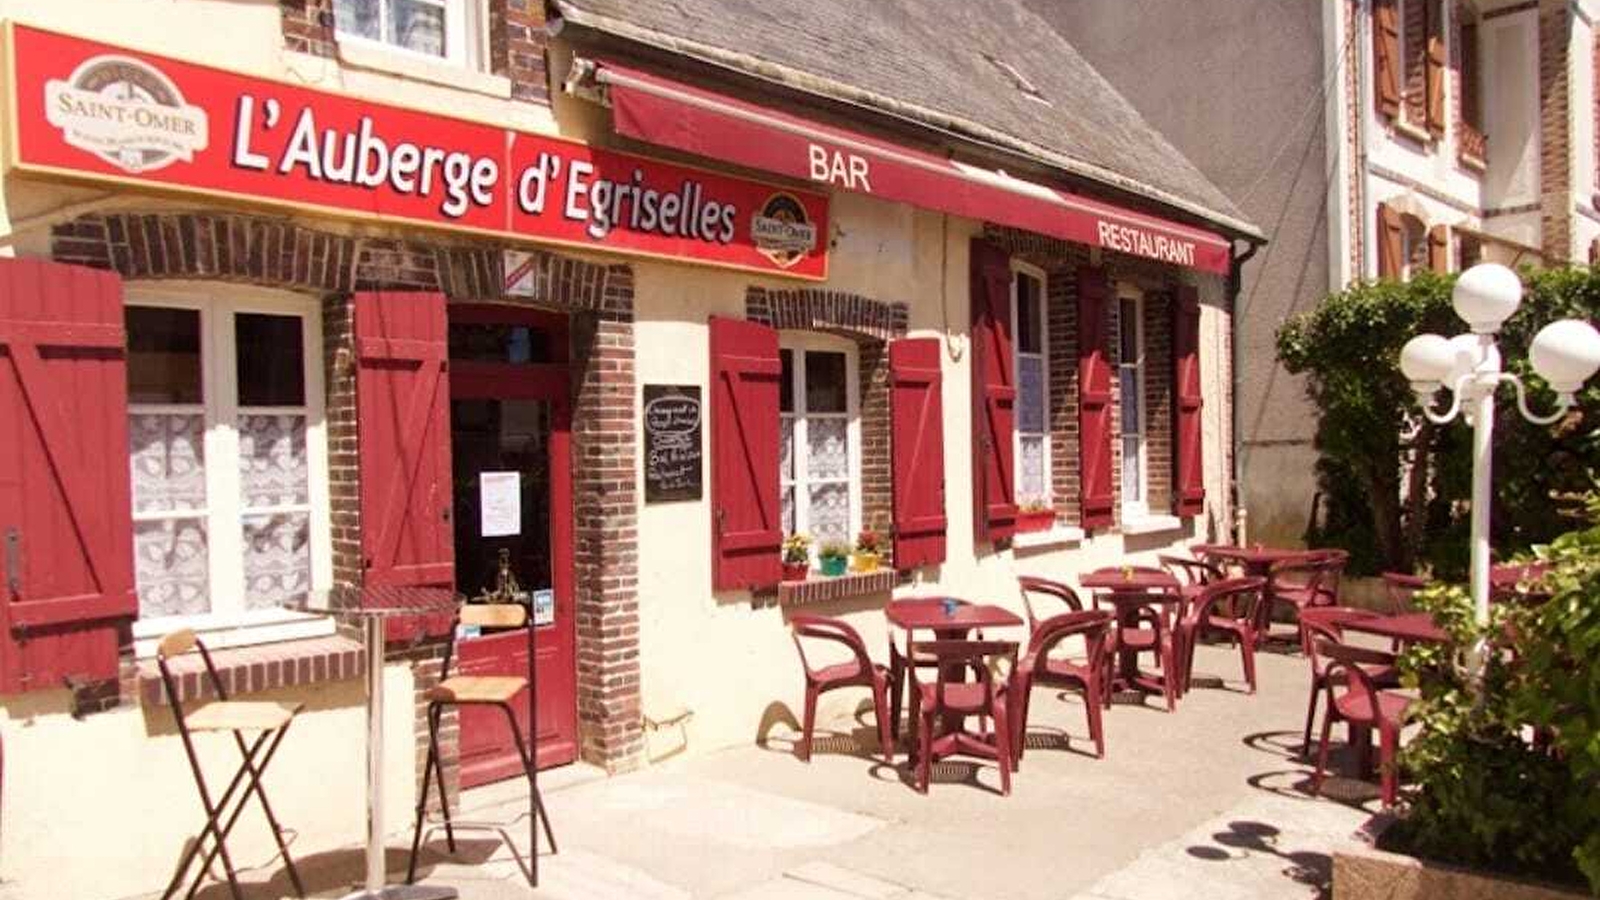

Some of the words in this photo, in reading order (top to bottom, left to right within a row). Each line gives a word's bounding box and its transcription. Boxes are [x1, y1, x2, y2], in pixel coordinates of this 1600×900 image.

[58, 92, 196, 135] SAINT-OMER
[234, 95, 499, 217] L'Auberge
[517, 151, 736, 244] d'Egriselles
[808, 144, 871, 192] BAR
[1097, 220, 1196, 266] RESTAURANT
